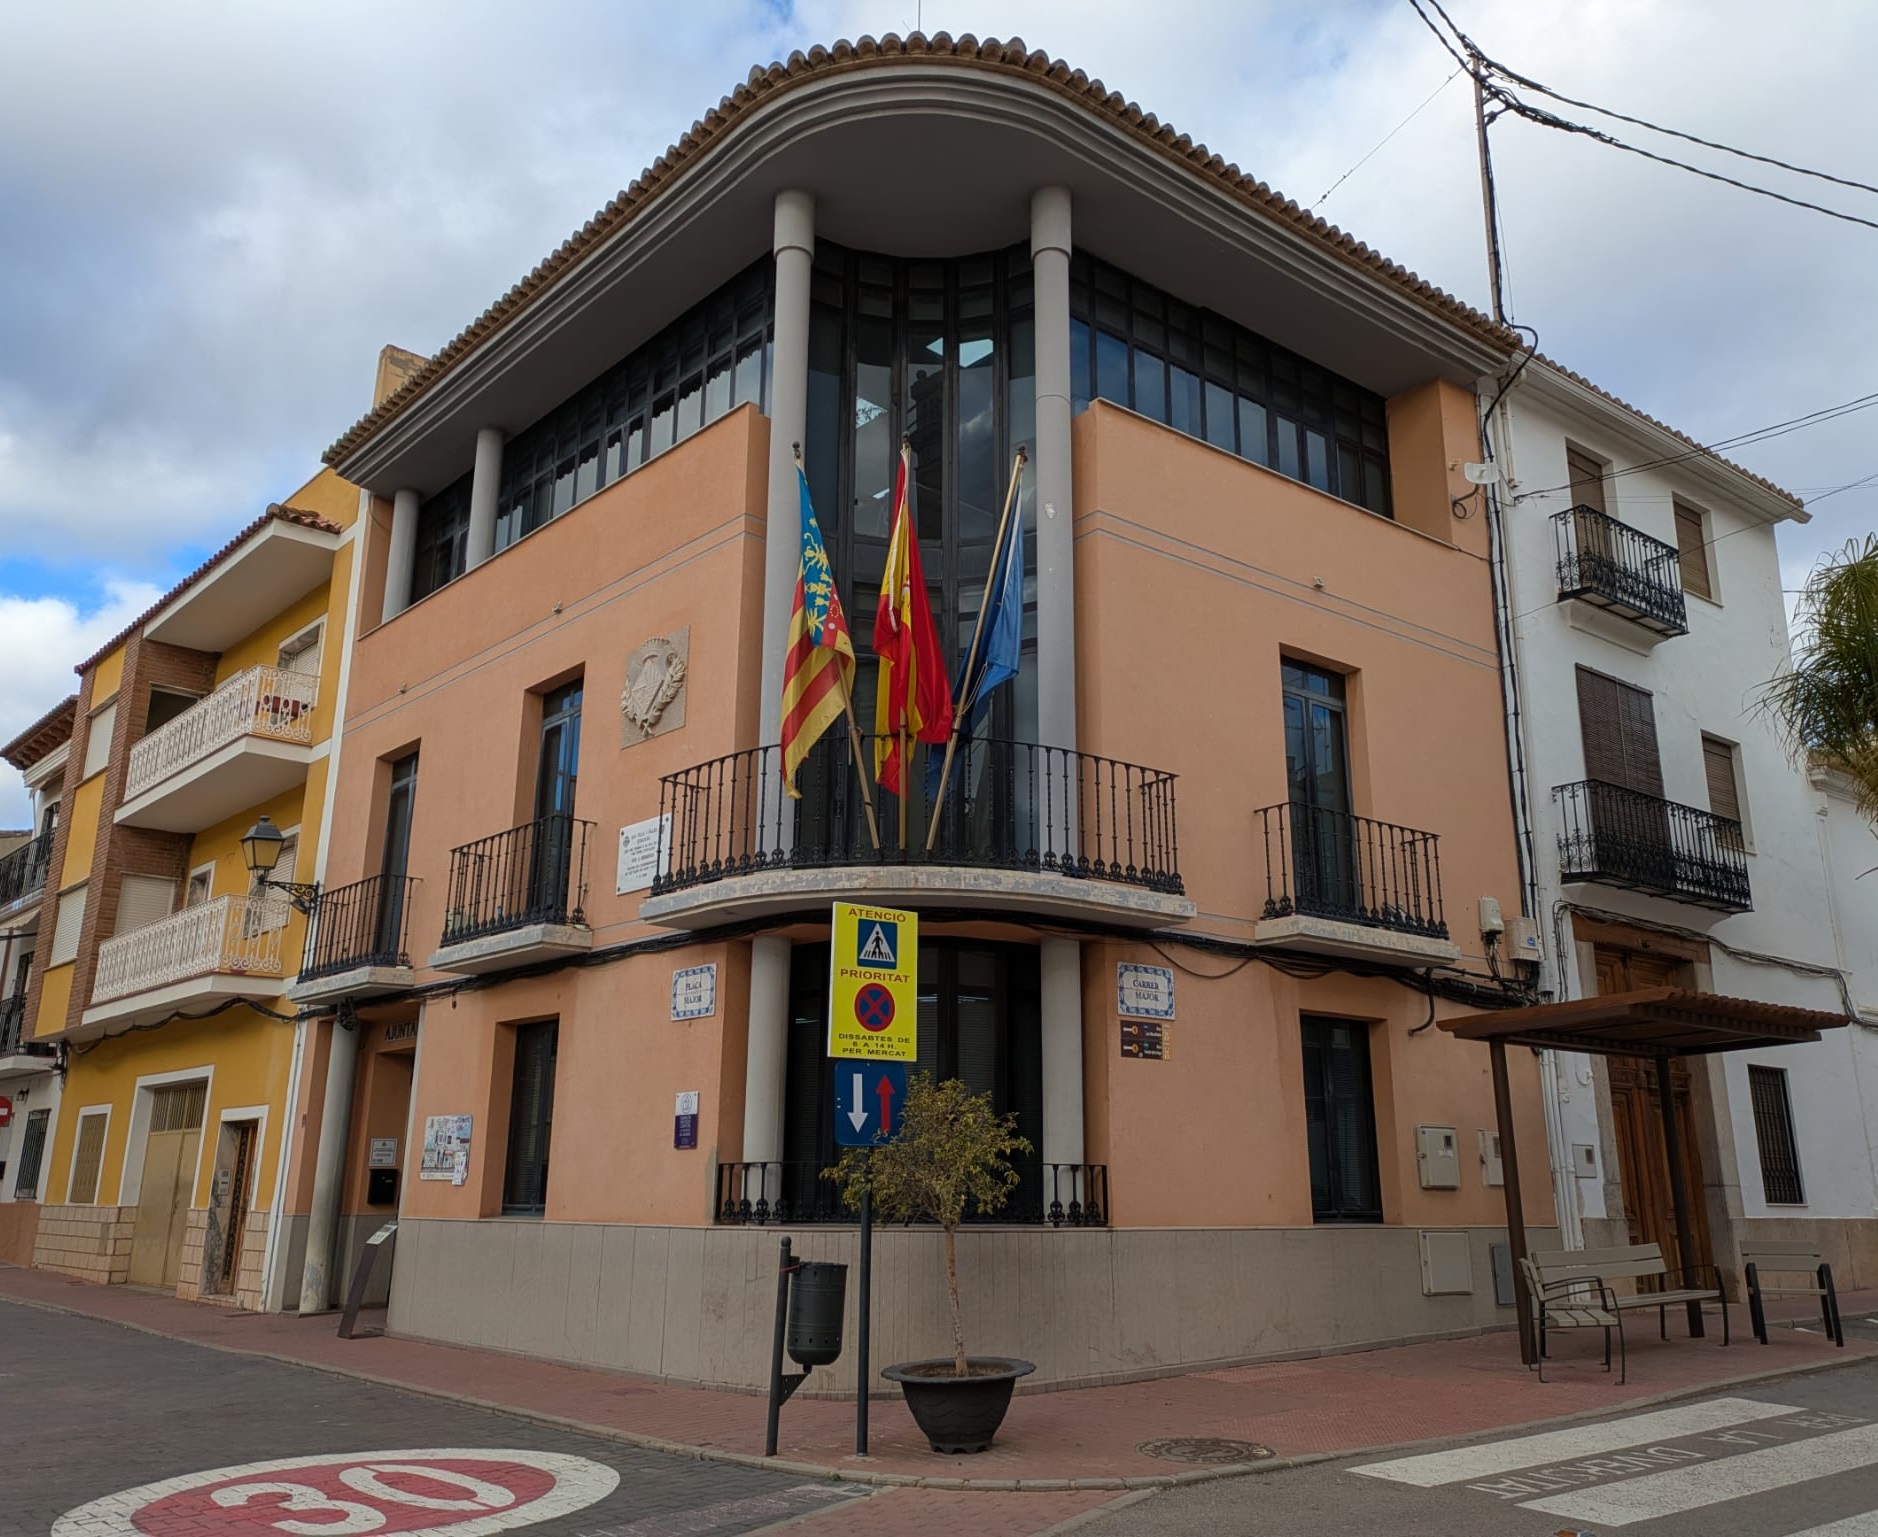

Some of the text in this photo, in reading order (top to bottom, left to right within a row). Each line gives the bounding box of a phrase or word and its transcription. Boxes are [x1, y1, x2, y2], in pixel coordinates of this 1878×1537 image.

[848, 908, 906, 923] ATENCIÓ
[840, 969, 910, 983] PRIORITAT
[384, 1022, 418, 1040] AJUNTA
[838, 1033, 893, 1042] DISSABTES
[210, 1464, 516, 1535] 30
